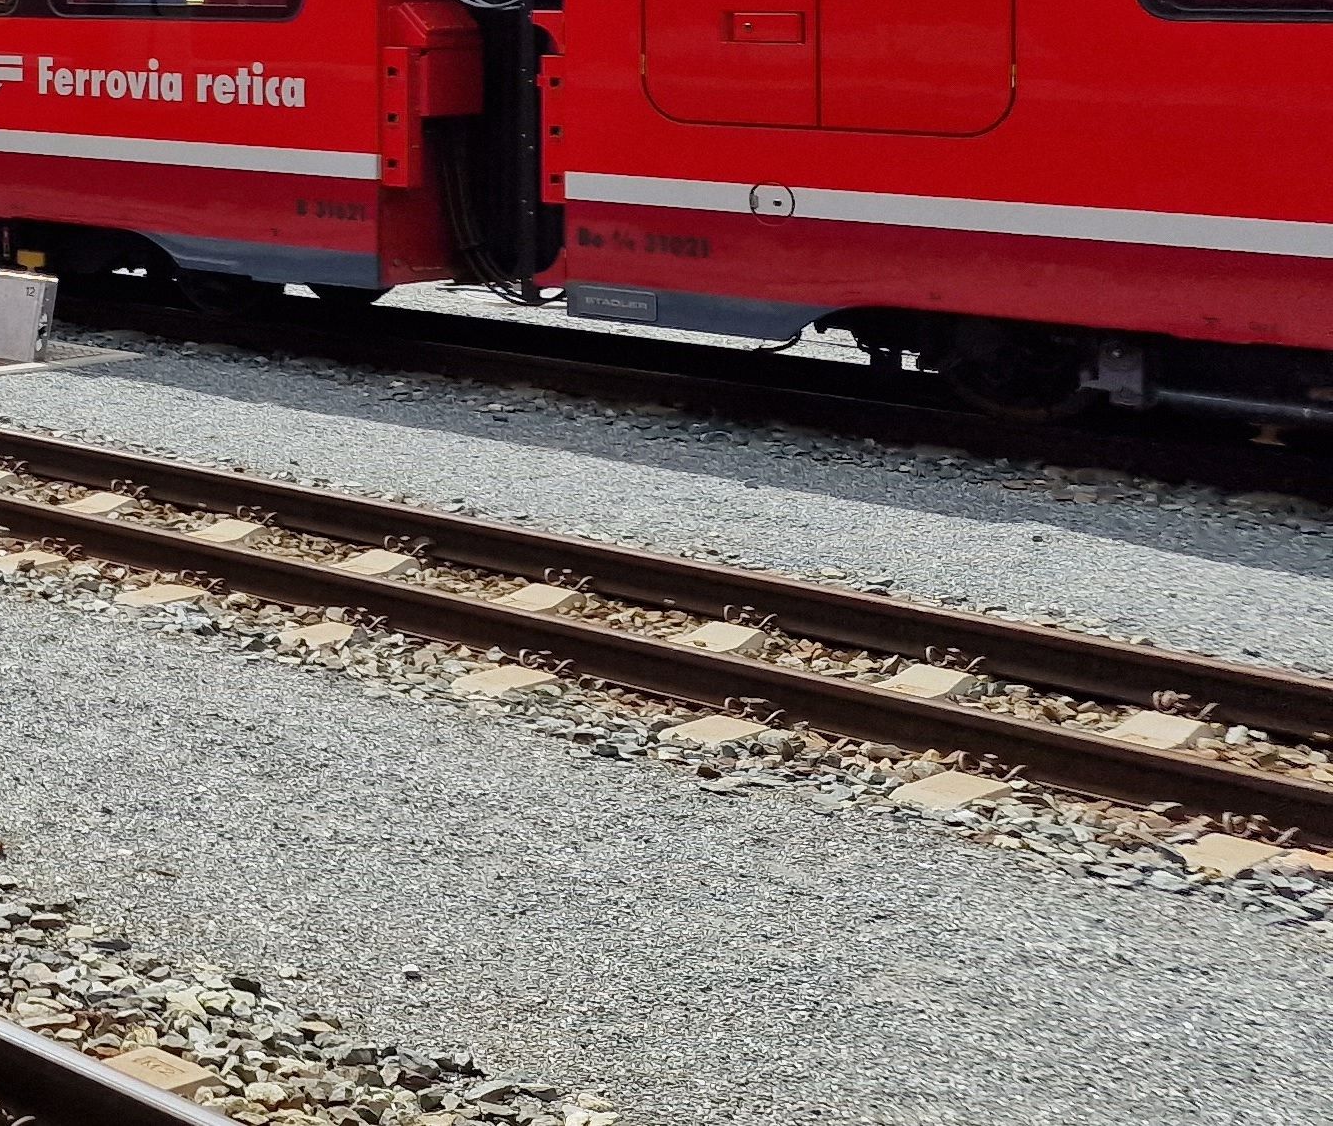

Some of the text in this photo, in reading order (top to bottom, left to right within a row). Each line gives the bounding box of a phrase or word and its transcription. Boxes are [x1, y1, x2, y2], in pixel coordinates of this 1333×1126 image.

[37, 56, 306, 108] Ferrovia retica
[26, 286, 36, 298] 12
